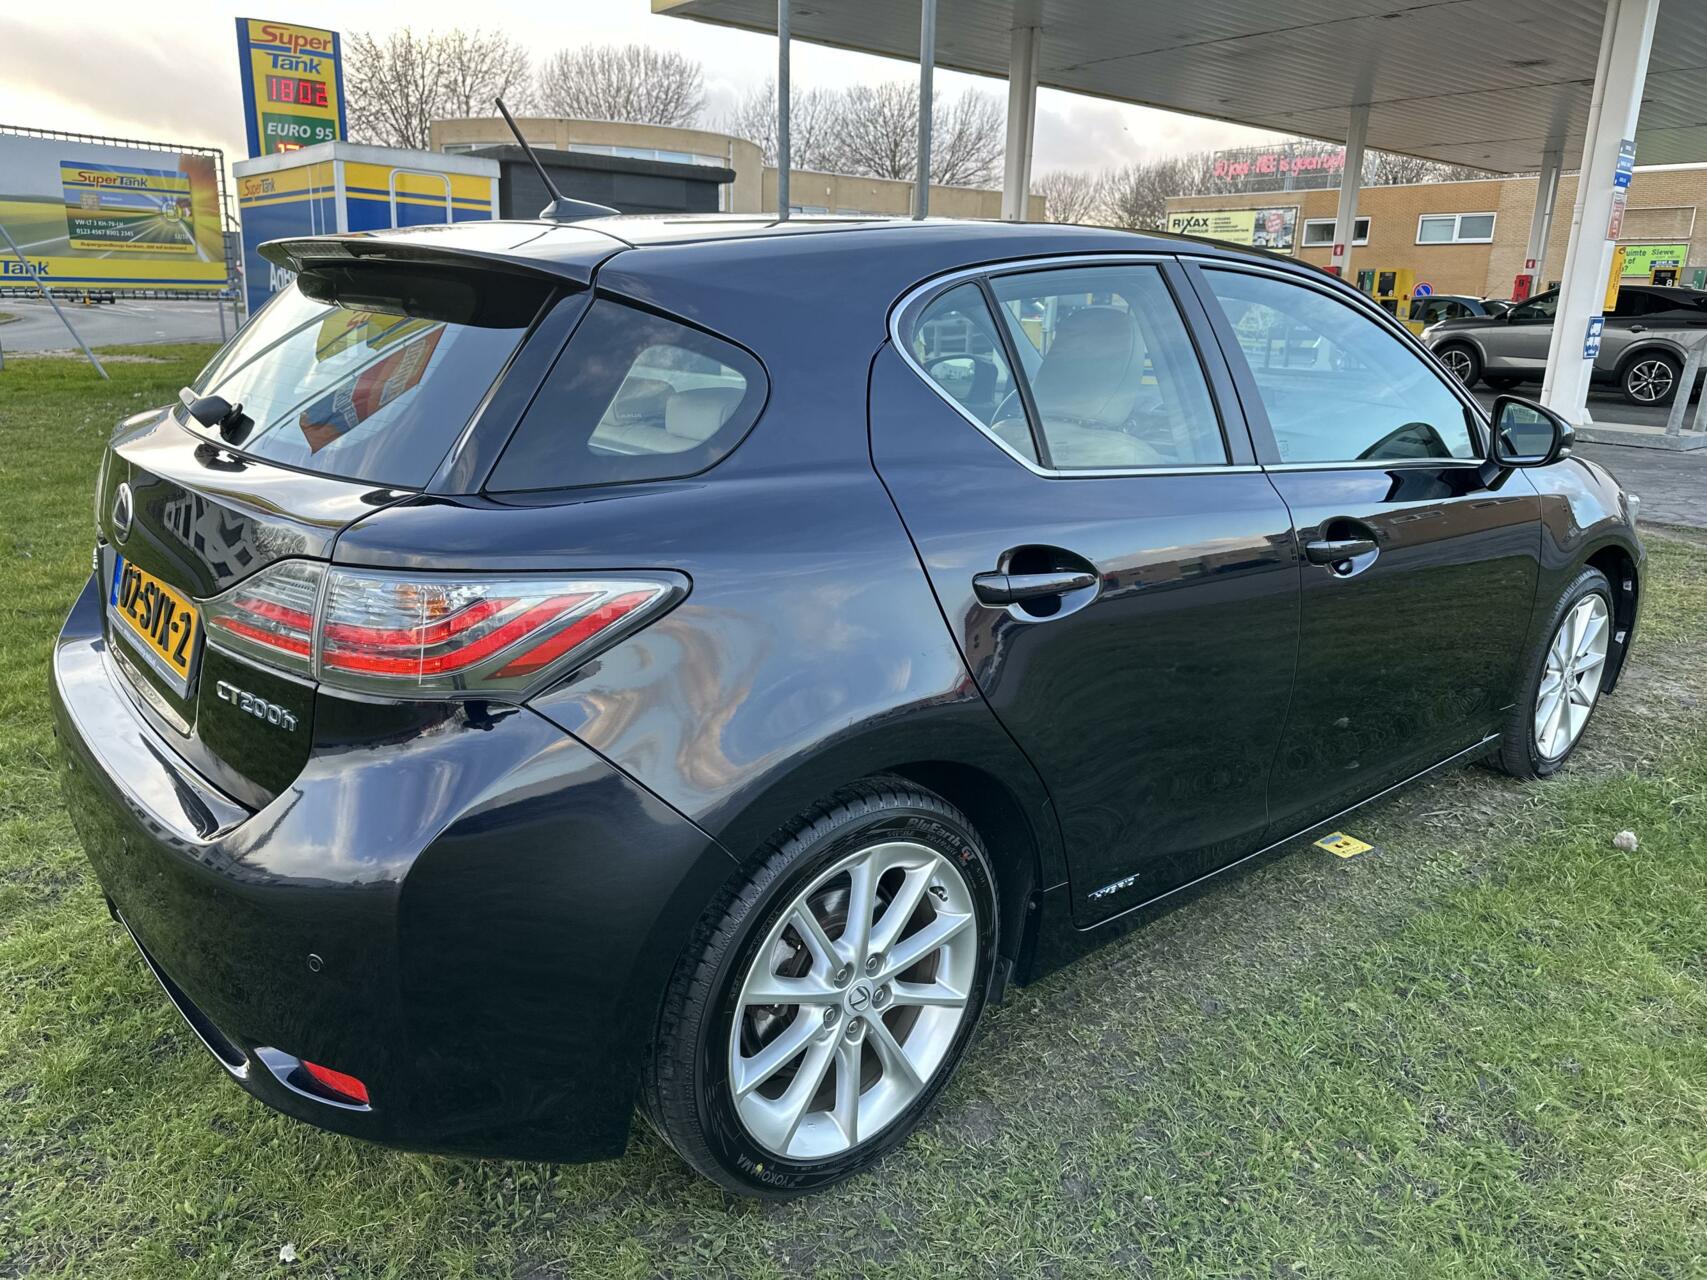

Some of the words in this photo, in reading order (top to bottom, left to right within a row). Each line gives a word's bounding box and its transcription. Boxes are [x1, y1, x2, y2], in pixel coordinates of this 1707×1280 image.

[250, 25, 331, 54] Super
[265, 52, 321, 74] Tank
[271, 79, 328, 106] 1802
[266, 122, 311, 138] EURO
[315, 127, 334, 140] 95
[1172, 217, 1209, 233] RIXAX
[1665, 279, 1673, 287] 8
